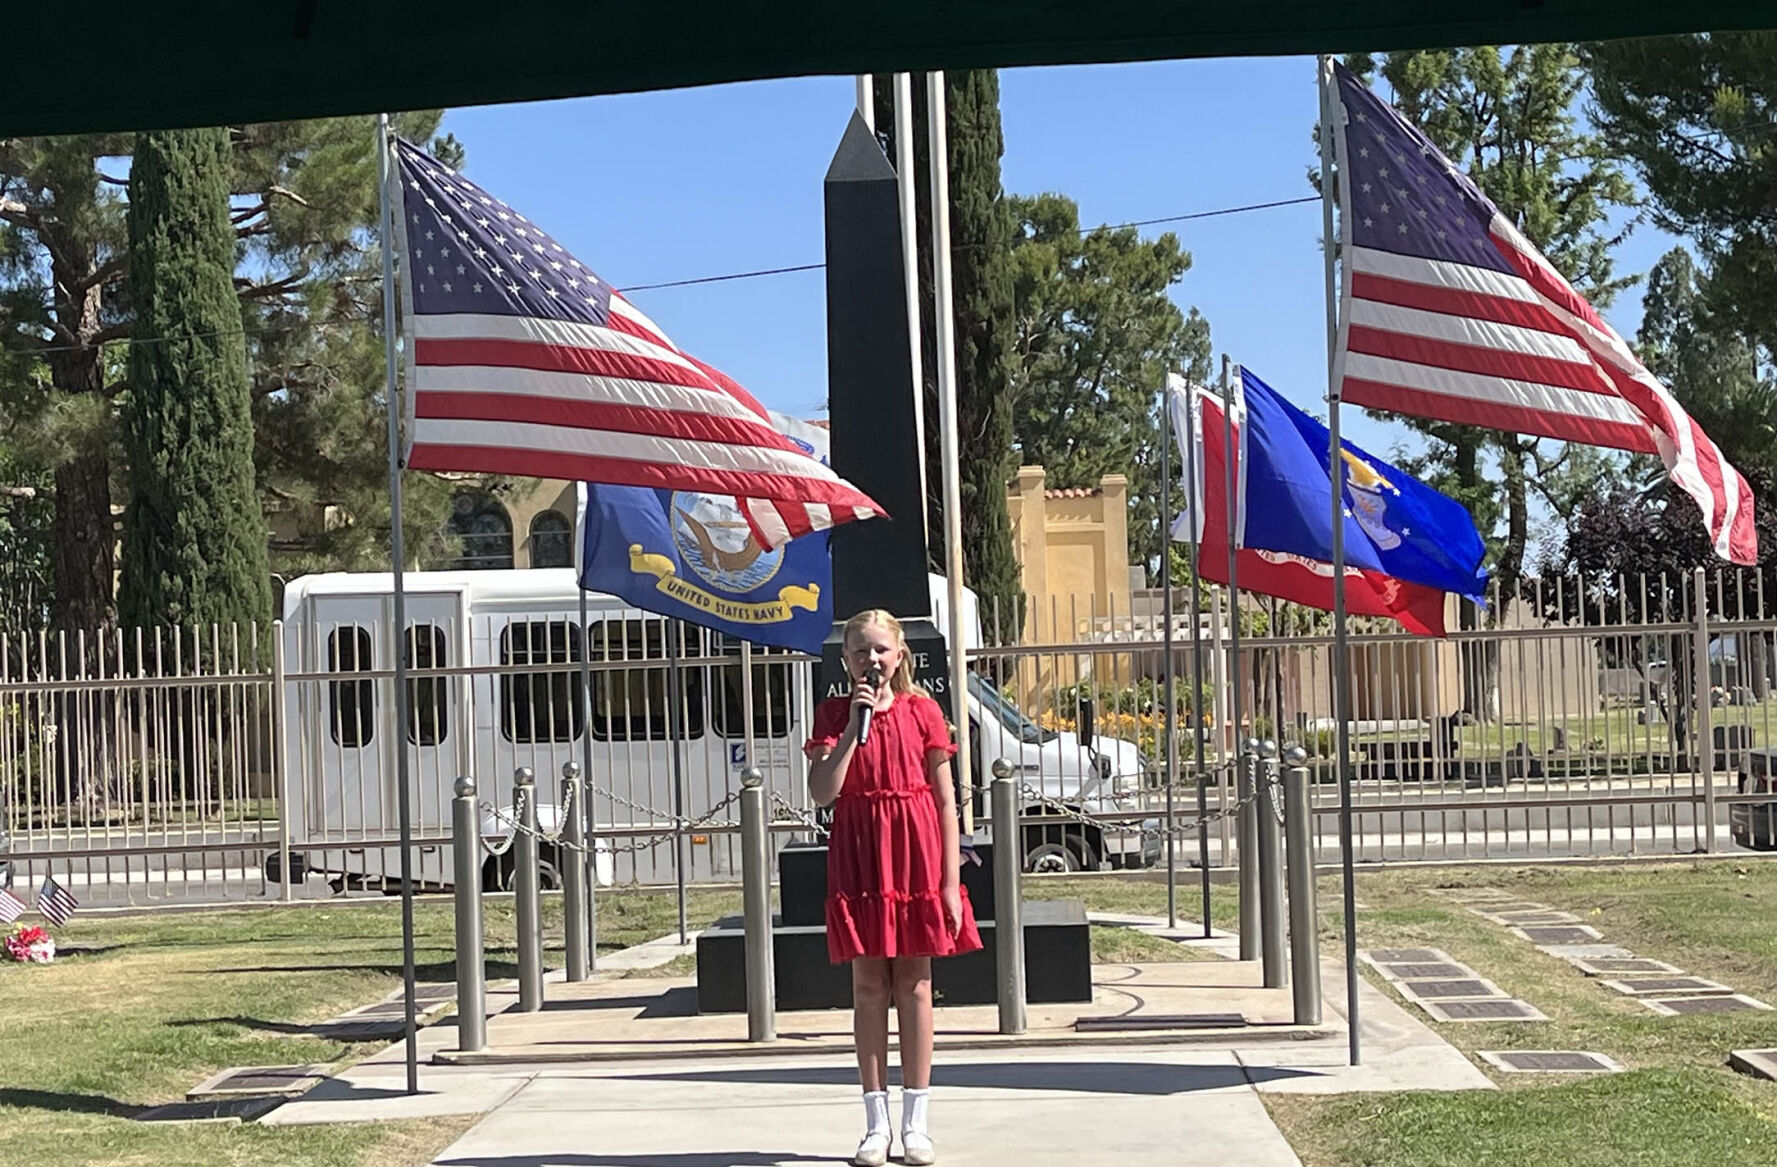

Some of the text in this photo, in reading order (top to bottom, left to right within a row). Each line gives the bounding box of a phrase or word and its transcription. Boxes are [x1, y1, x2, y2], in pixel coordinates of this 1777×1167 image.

[667, 581, 783, 621] UNITED STATES NAVY
